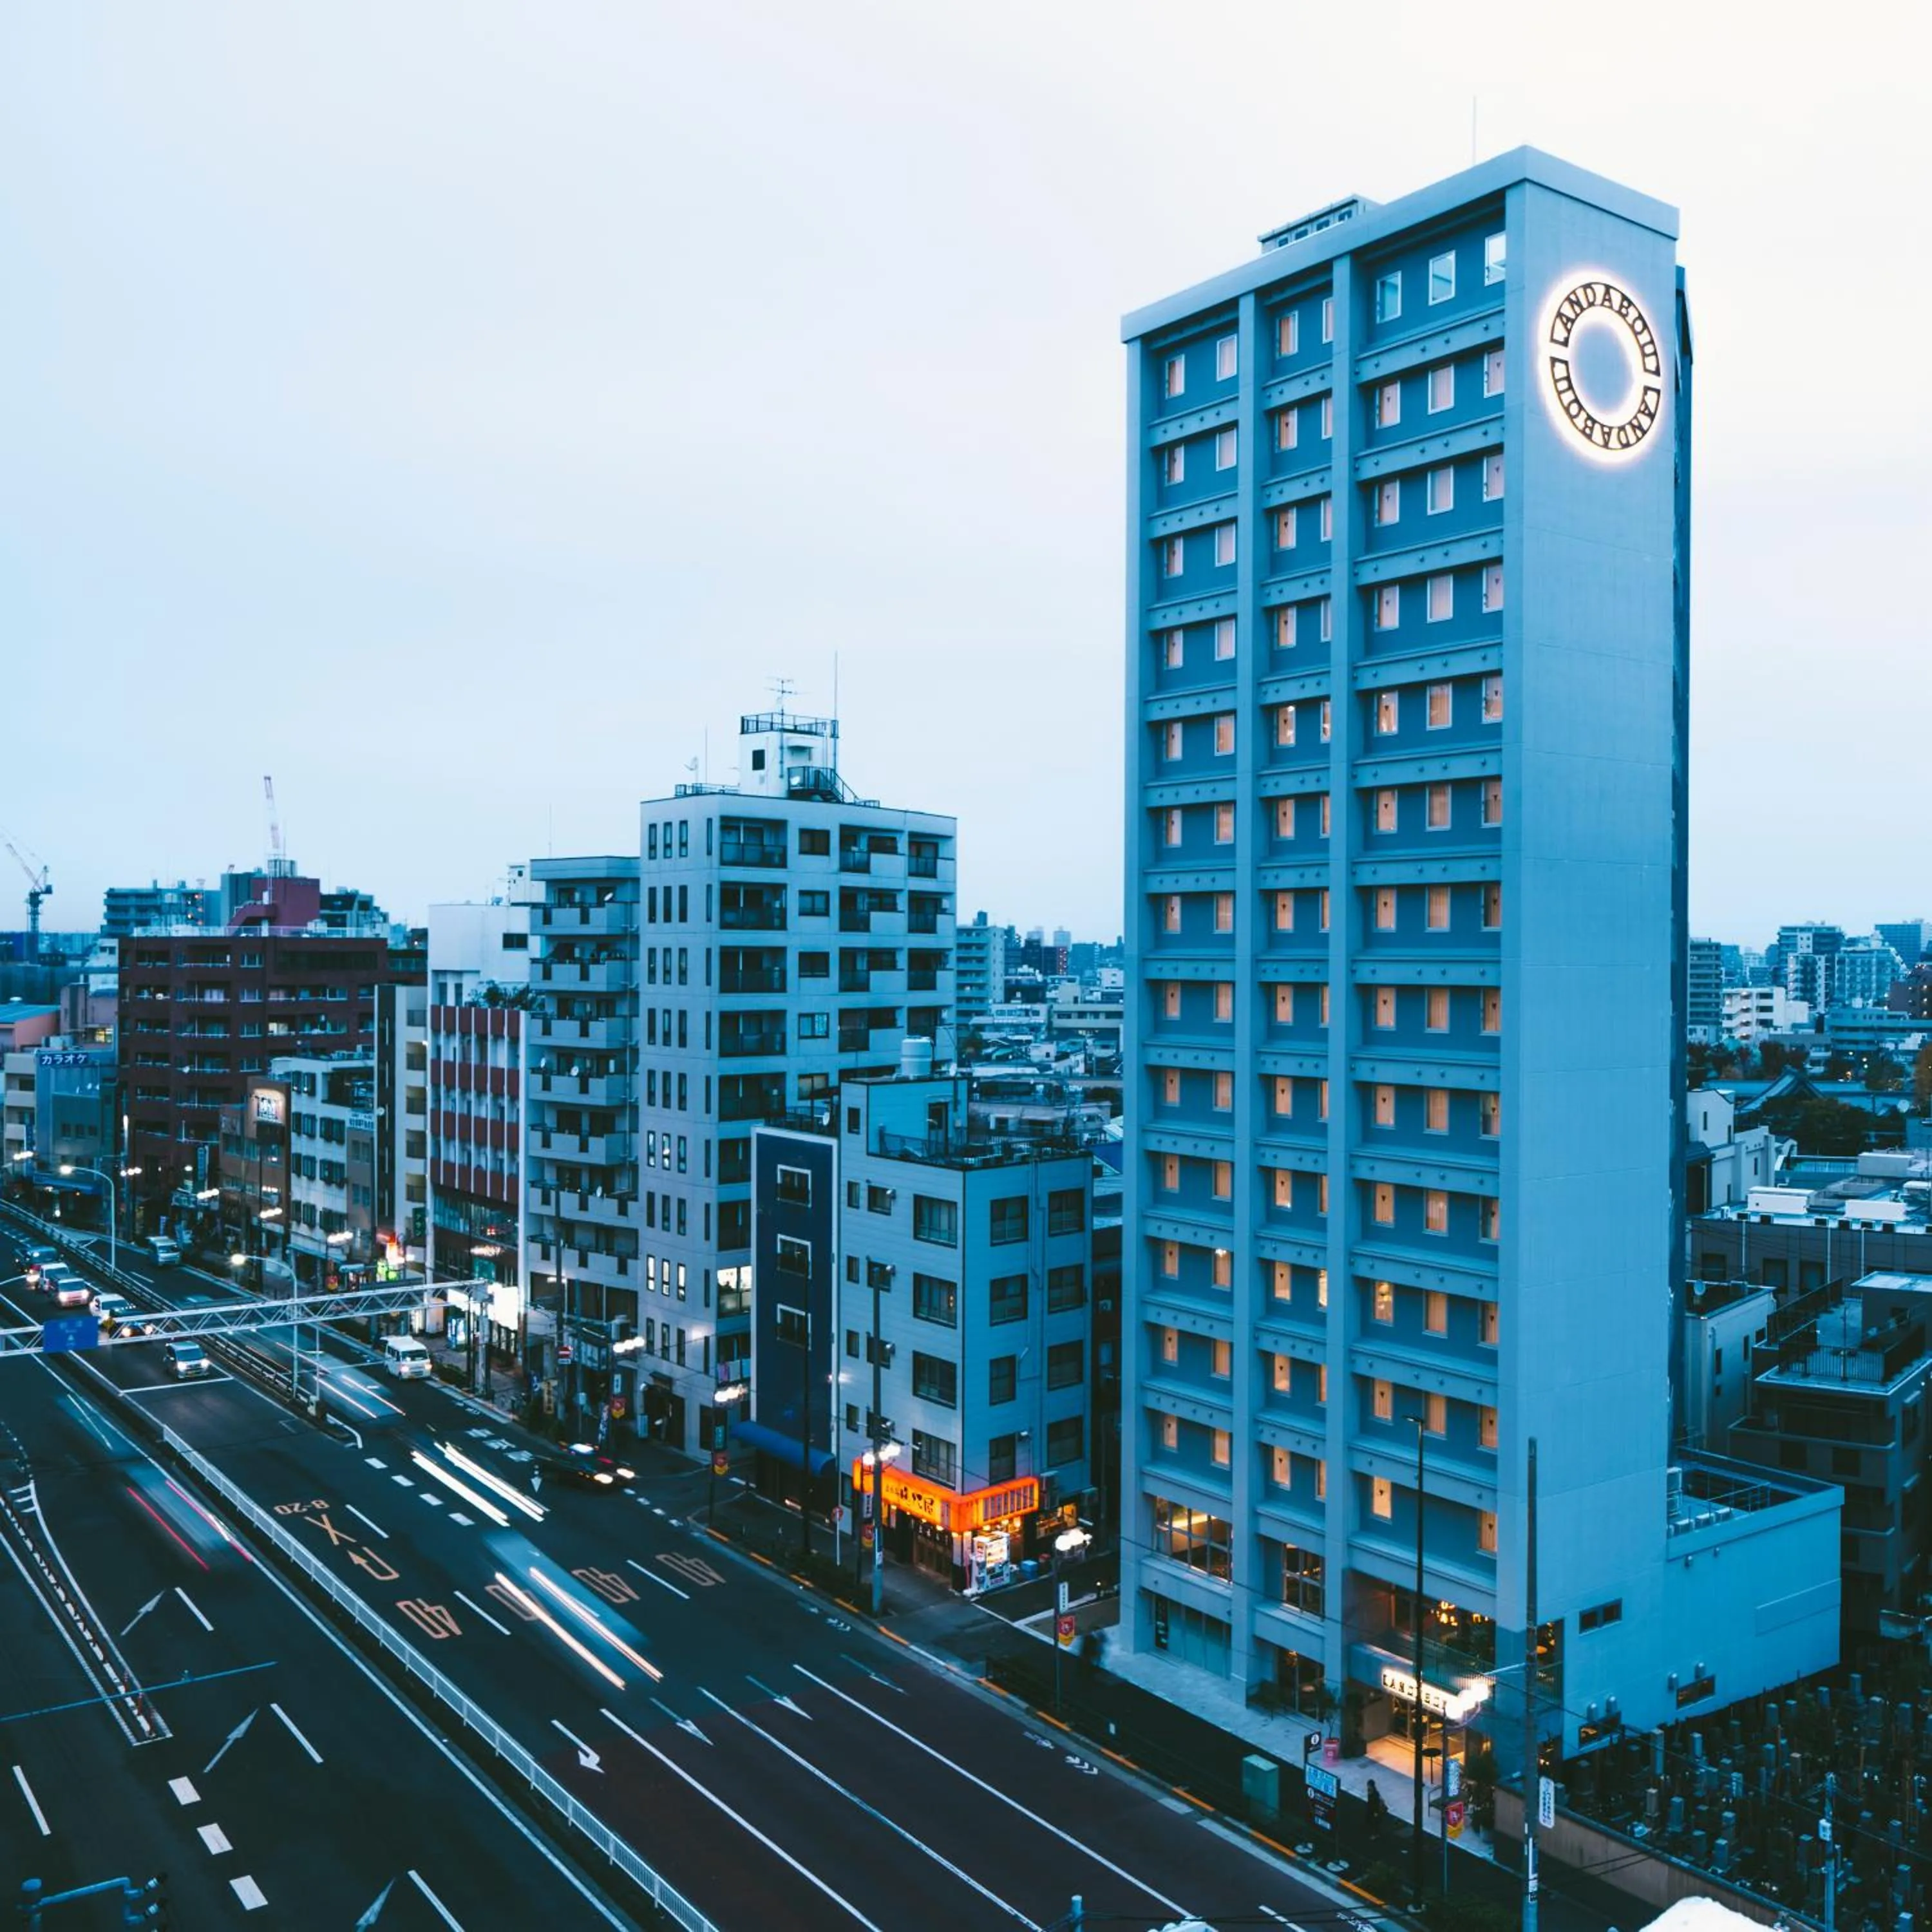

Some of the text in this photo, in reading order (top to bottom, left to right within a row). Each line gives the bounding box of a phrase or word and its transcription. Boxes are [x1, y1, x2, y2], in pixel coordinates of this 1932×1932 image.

[41, 1054, 87, 1065] カラオケ
[571, 1566, 641, 1604] 40
[655, 1552, 726, 1587] 40
[395, 1597, 462, 1640] 40
